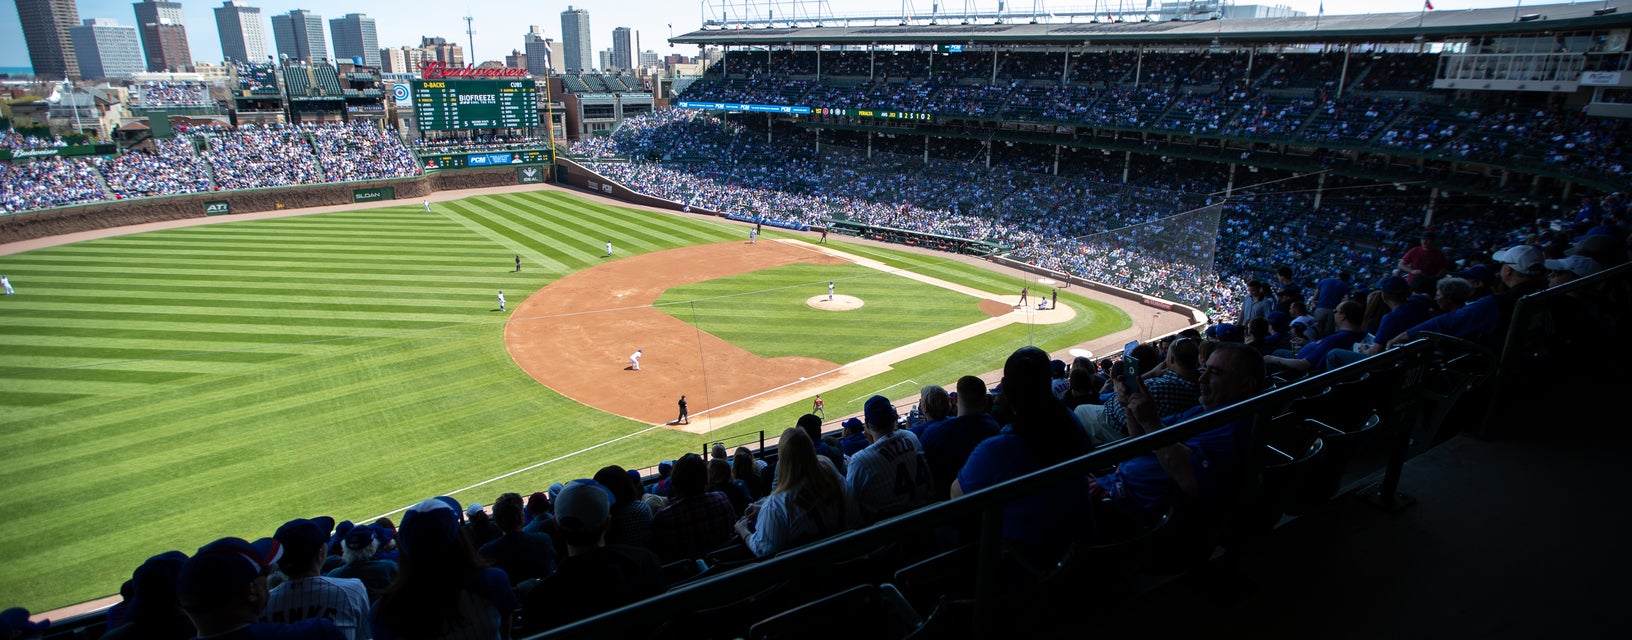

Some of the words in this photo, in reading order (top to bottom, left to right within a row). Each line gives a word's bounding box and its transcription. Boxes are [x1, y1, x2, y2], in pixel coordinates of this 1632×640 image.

[416, 60, 527, 79] Budweiser
[10, 149, 58, 158] Budweiser
[207, 203, 228, 211] ATI
[879, 436, 915, 464] RIZZO
[895, 453, 932, 500] 44
[259, 606, 338, 623] ANKS
